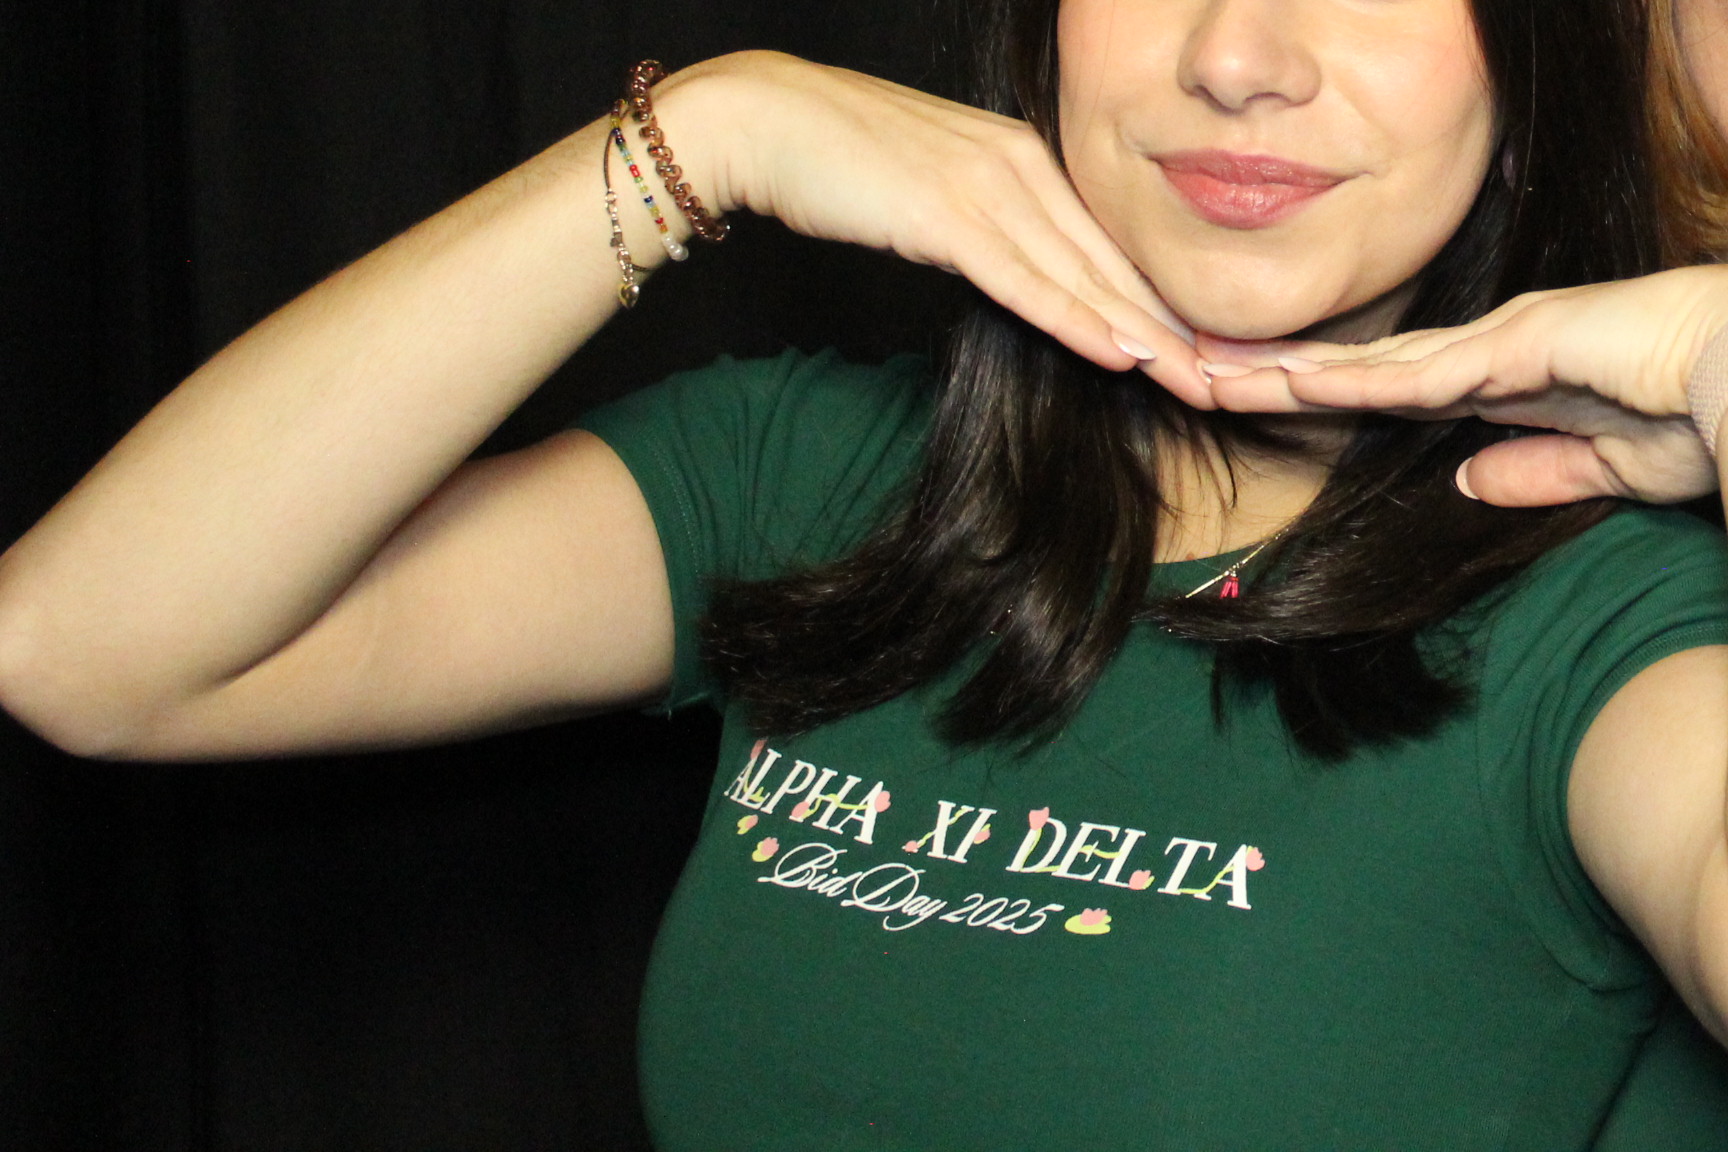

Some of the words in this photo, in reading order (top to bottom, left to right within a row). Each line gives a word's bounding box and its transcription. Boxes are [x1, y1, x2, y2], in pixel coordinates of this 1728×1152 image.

[724, 748, 884, 845] ALPHA
[902, 799, 998, 864] XI
[1005, 816, 1253, 910] DELTA
[757, 843, 862, 898] Bid
[840, 862, 947, 932] Day
[938, 893, 1065, 935] 2025
